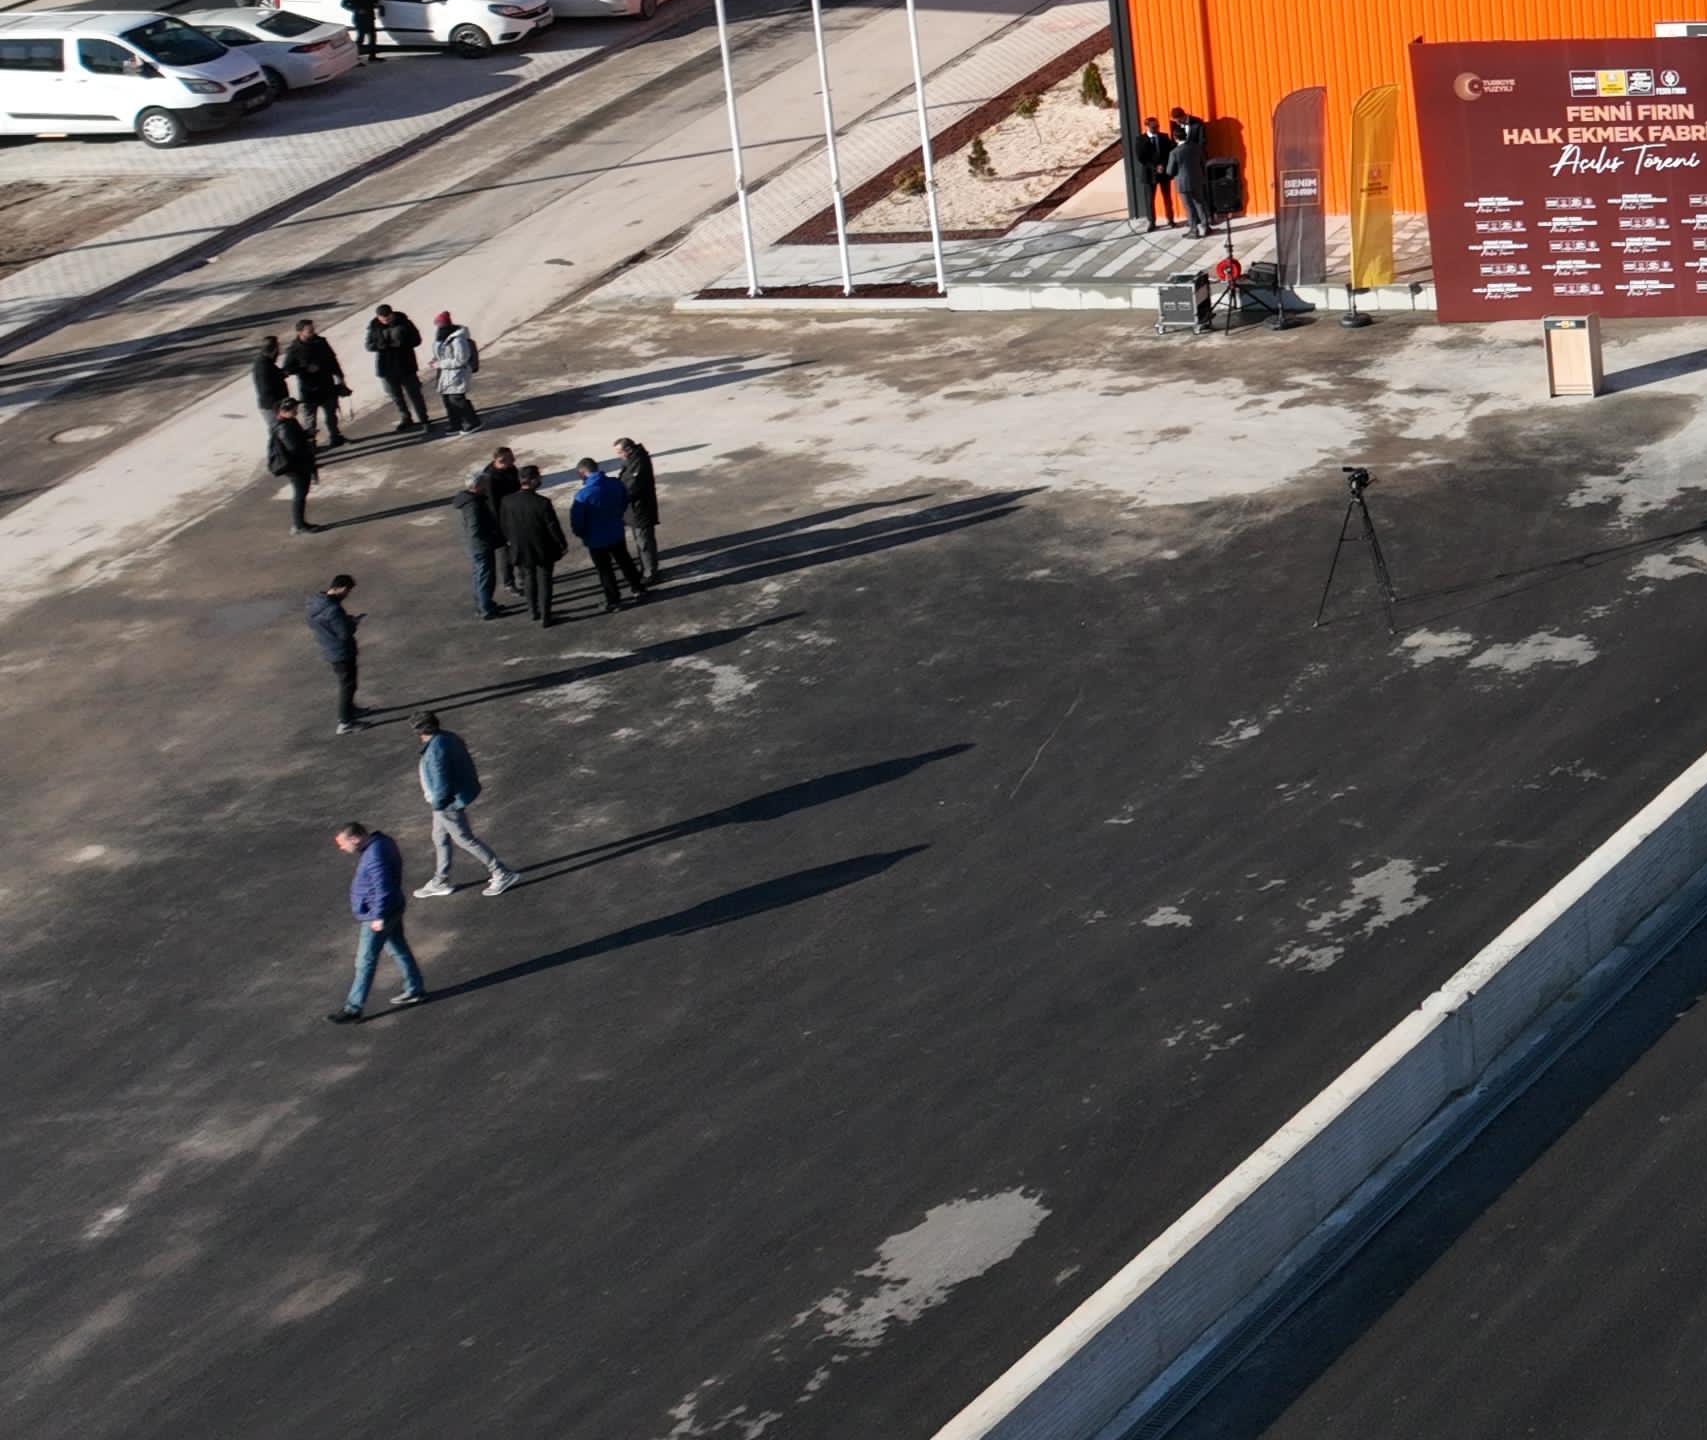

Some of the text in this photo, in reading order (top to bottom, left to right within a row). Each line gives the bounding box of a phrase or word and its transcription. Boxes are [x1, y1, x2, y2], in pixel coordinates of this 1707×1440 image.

[1566, 101, 1695, 122] FENNİ FIRIN
[1502, 127, 1563, 145] HALK
[1568, 124, 1644, 144] EKMEK
[1549, 143, 1701, 177] Açılış Töreni
